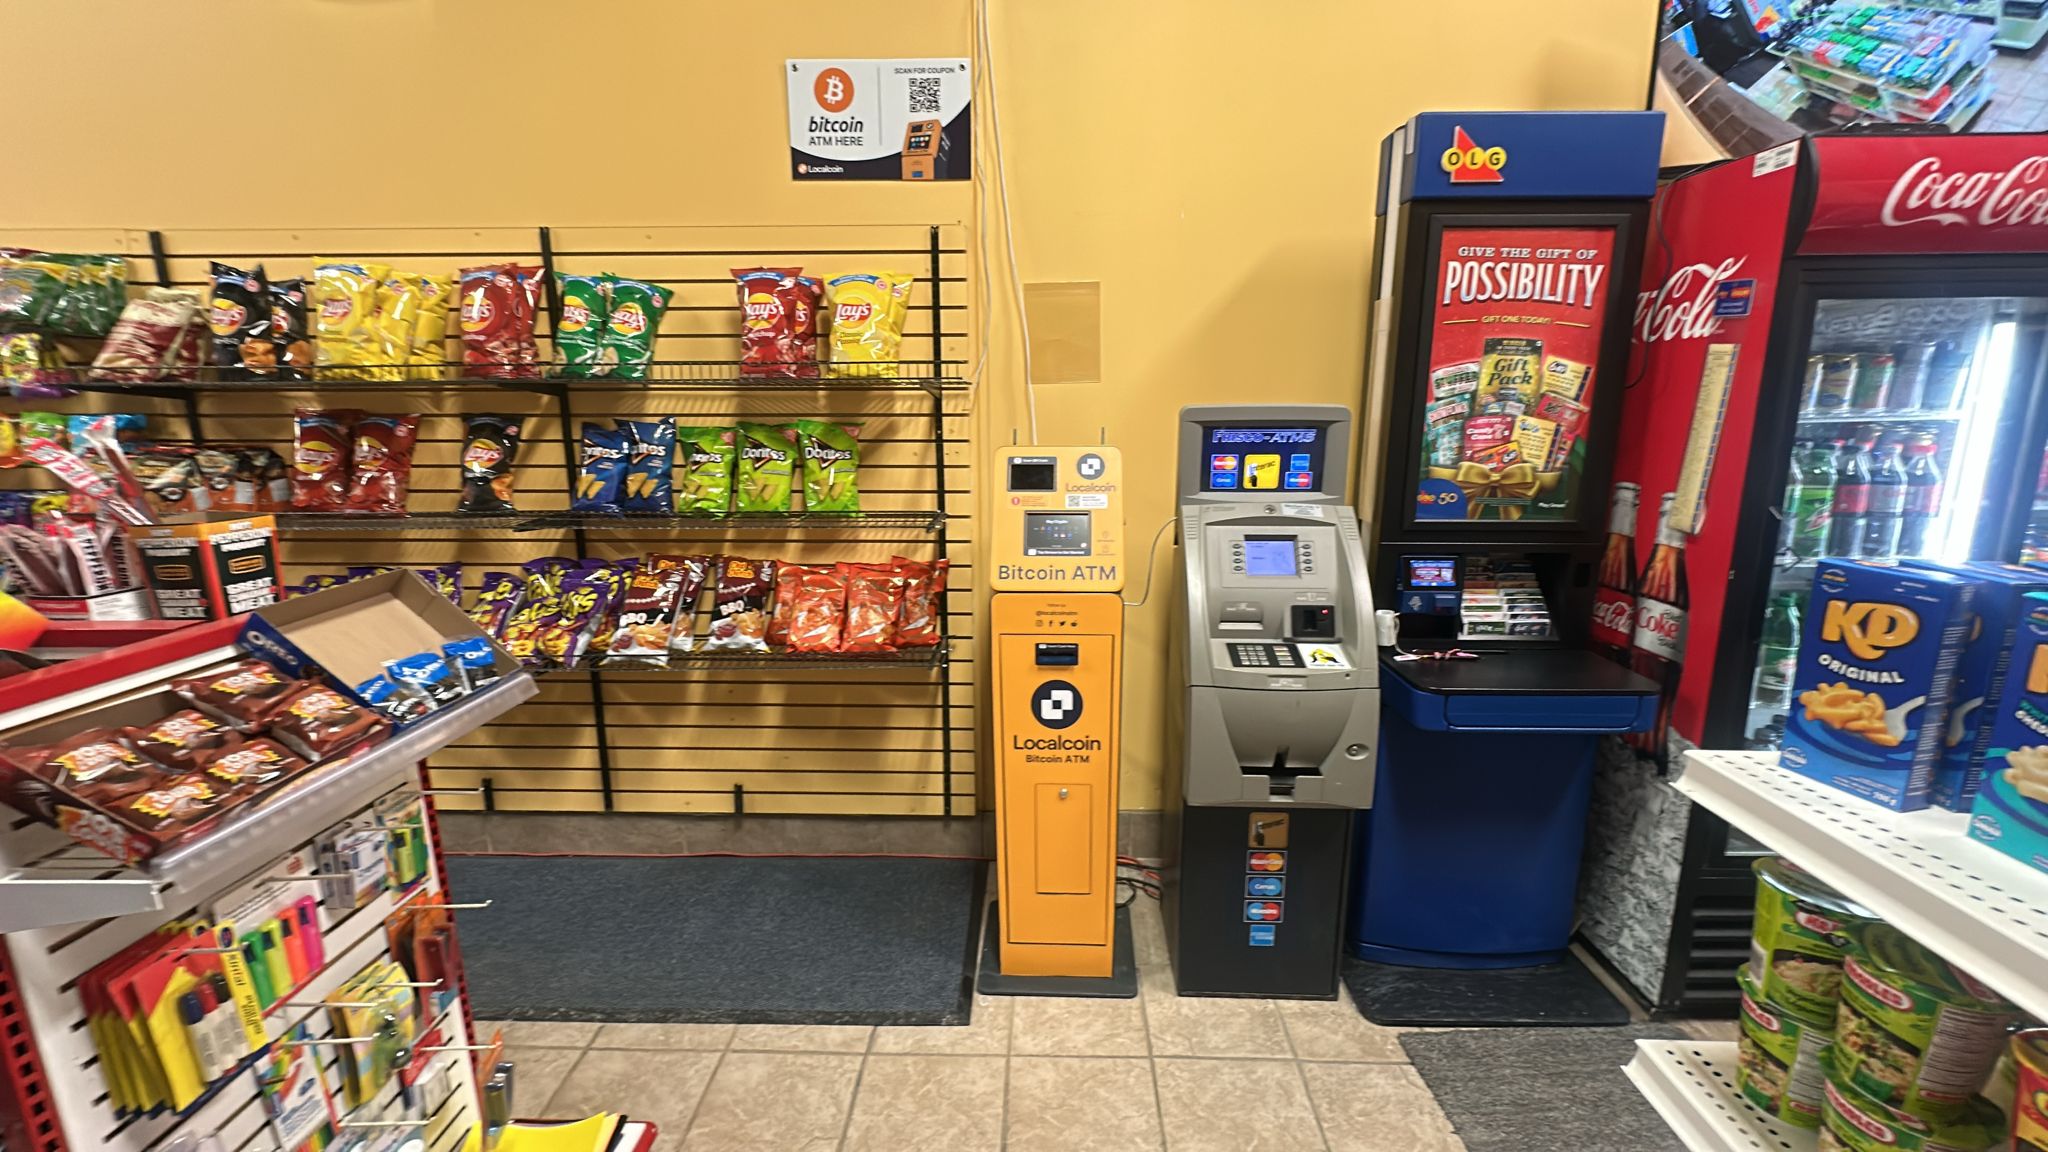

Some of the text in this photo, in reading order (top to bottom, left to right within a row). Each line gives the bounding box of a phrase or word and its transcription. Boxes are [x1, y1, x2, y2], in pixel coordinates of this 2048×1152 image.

[809, 116, 863, 132] bitcoin
[810, 136, 863, 145] ATM HERE
[1448, 152, 1501, 166] OLG
[808, 164, 844, 173] Localcoin
[1458, 246, 1599, 260] GIVE THE GIFT OF
[1443, 260, 1605, 308] POSSIBILITY
[835, 303, 872, 324] Lay's
[1494, 358, 1528, 371] Gift
[1488, 373, 1533, 387] Pack
[741, 446, 786, 462] Doritos
[1066, 483, 1116, 492] Localcoin
[998, 565, 1116, 580] Bitcoin ATM
[720, 600, 745, 615] BBQ
[1822, 599, 1921, 660] KD
[1818, 654, 1905, 684] ORIGINAL
[1013, 735, 1101, 750] Localcoin
[1026, 754, 1089, 763] Bitcoin ATM
